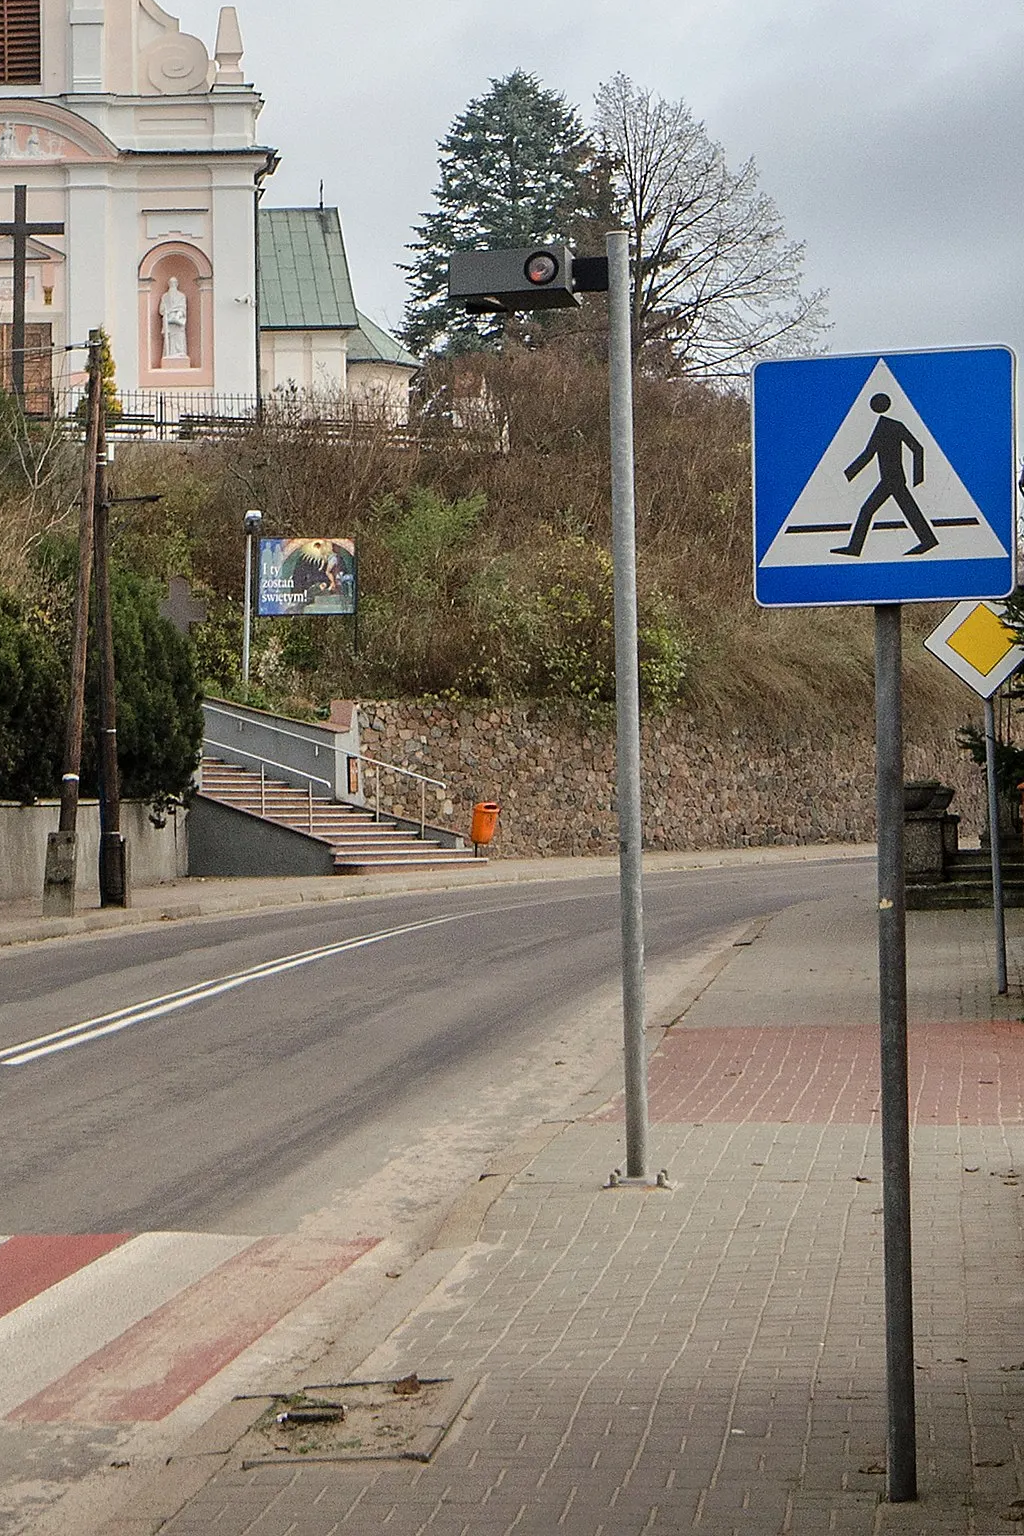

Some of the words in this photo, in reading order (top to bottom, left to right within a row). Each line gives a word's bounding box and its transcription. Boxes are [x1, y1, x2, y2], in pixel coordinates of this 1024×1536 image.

[263, 563, 267, 575] I
[270, 565, 280, 576] ty
[262, 575, 294, 588] zostań
[261, 590, 308, 606] świętym!
